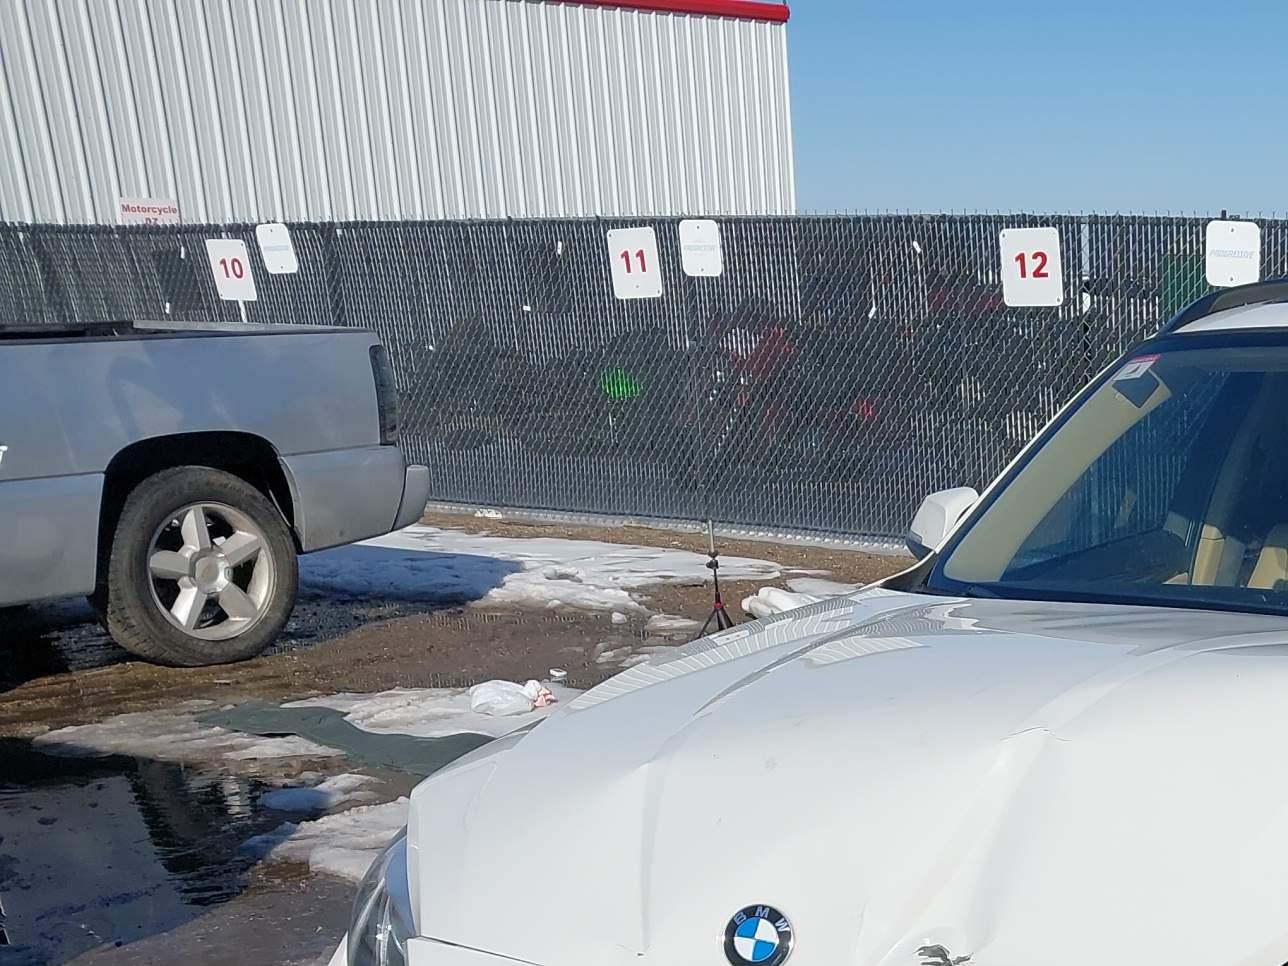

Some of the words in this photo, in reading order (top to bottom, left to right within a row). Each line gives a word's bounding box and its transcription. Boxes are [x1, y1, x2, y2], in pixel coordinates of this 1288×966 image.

[121, 204, 177, 215] Motorcycle
[219, 257, 244, 279] 10
[620, 249, 647, 273] 11
[1014, 251, 1049, 279] 12
[733, 905, 791, 932] BMW
